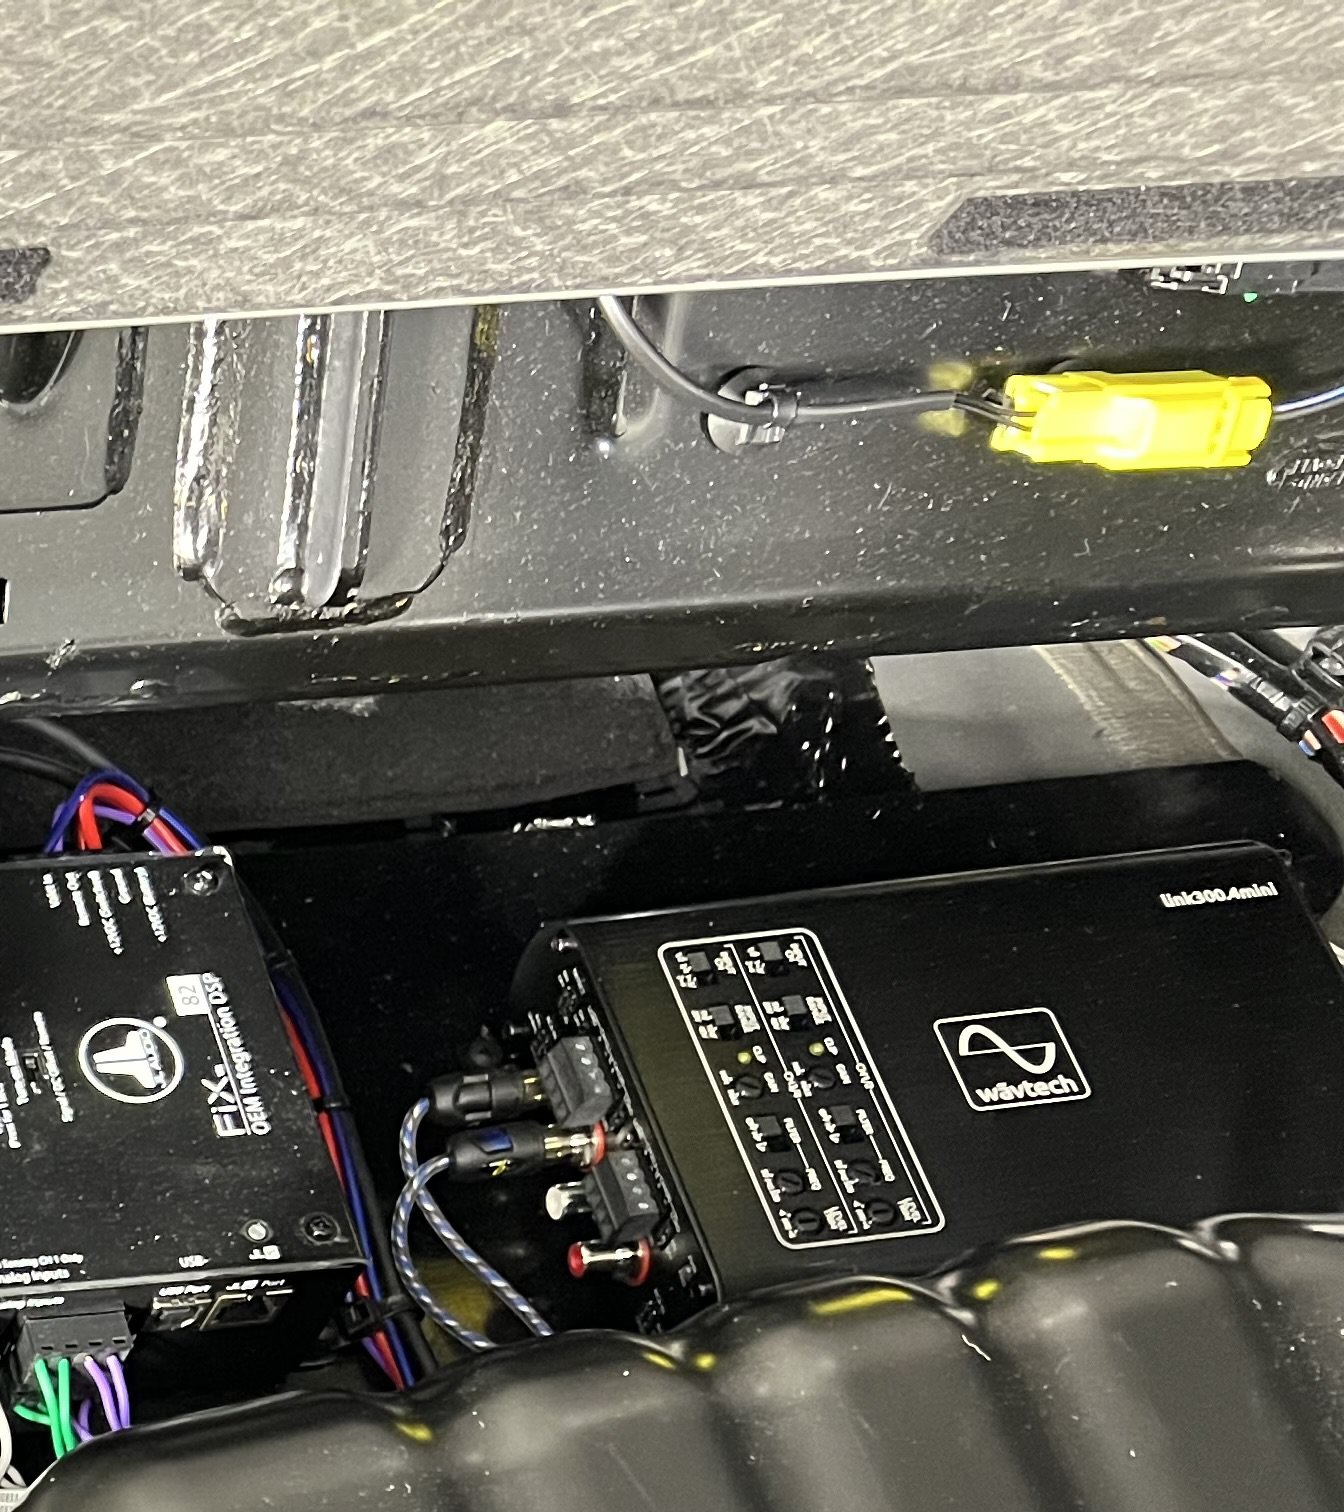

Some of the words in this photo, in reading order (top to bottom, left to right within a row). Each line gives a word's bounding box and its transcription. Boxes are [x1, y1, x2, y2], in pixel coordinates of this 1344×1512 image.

[178, 984, 200, 1006] 82
[202, 972, 229, 1005] DSP
[216, 1006, 259, 1095] Integration
[242, 1096, 272, 1136] OEM
[179, 1254, 205, 1268] USB
[31, 1268, 70, 1284] Inputs
